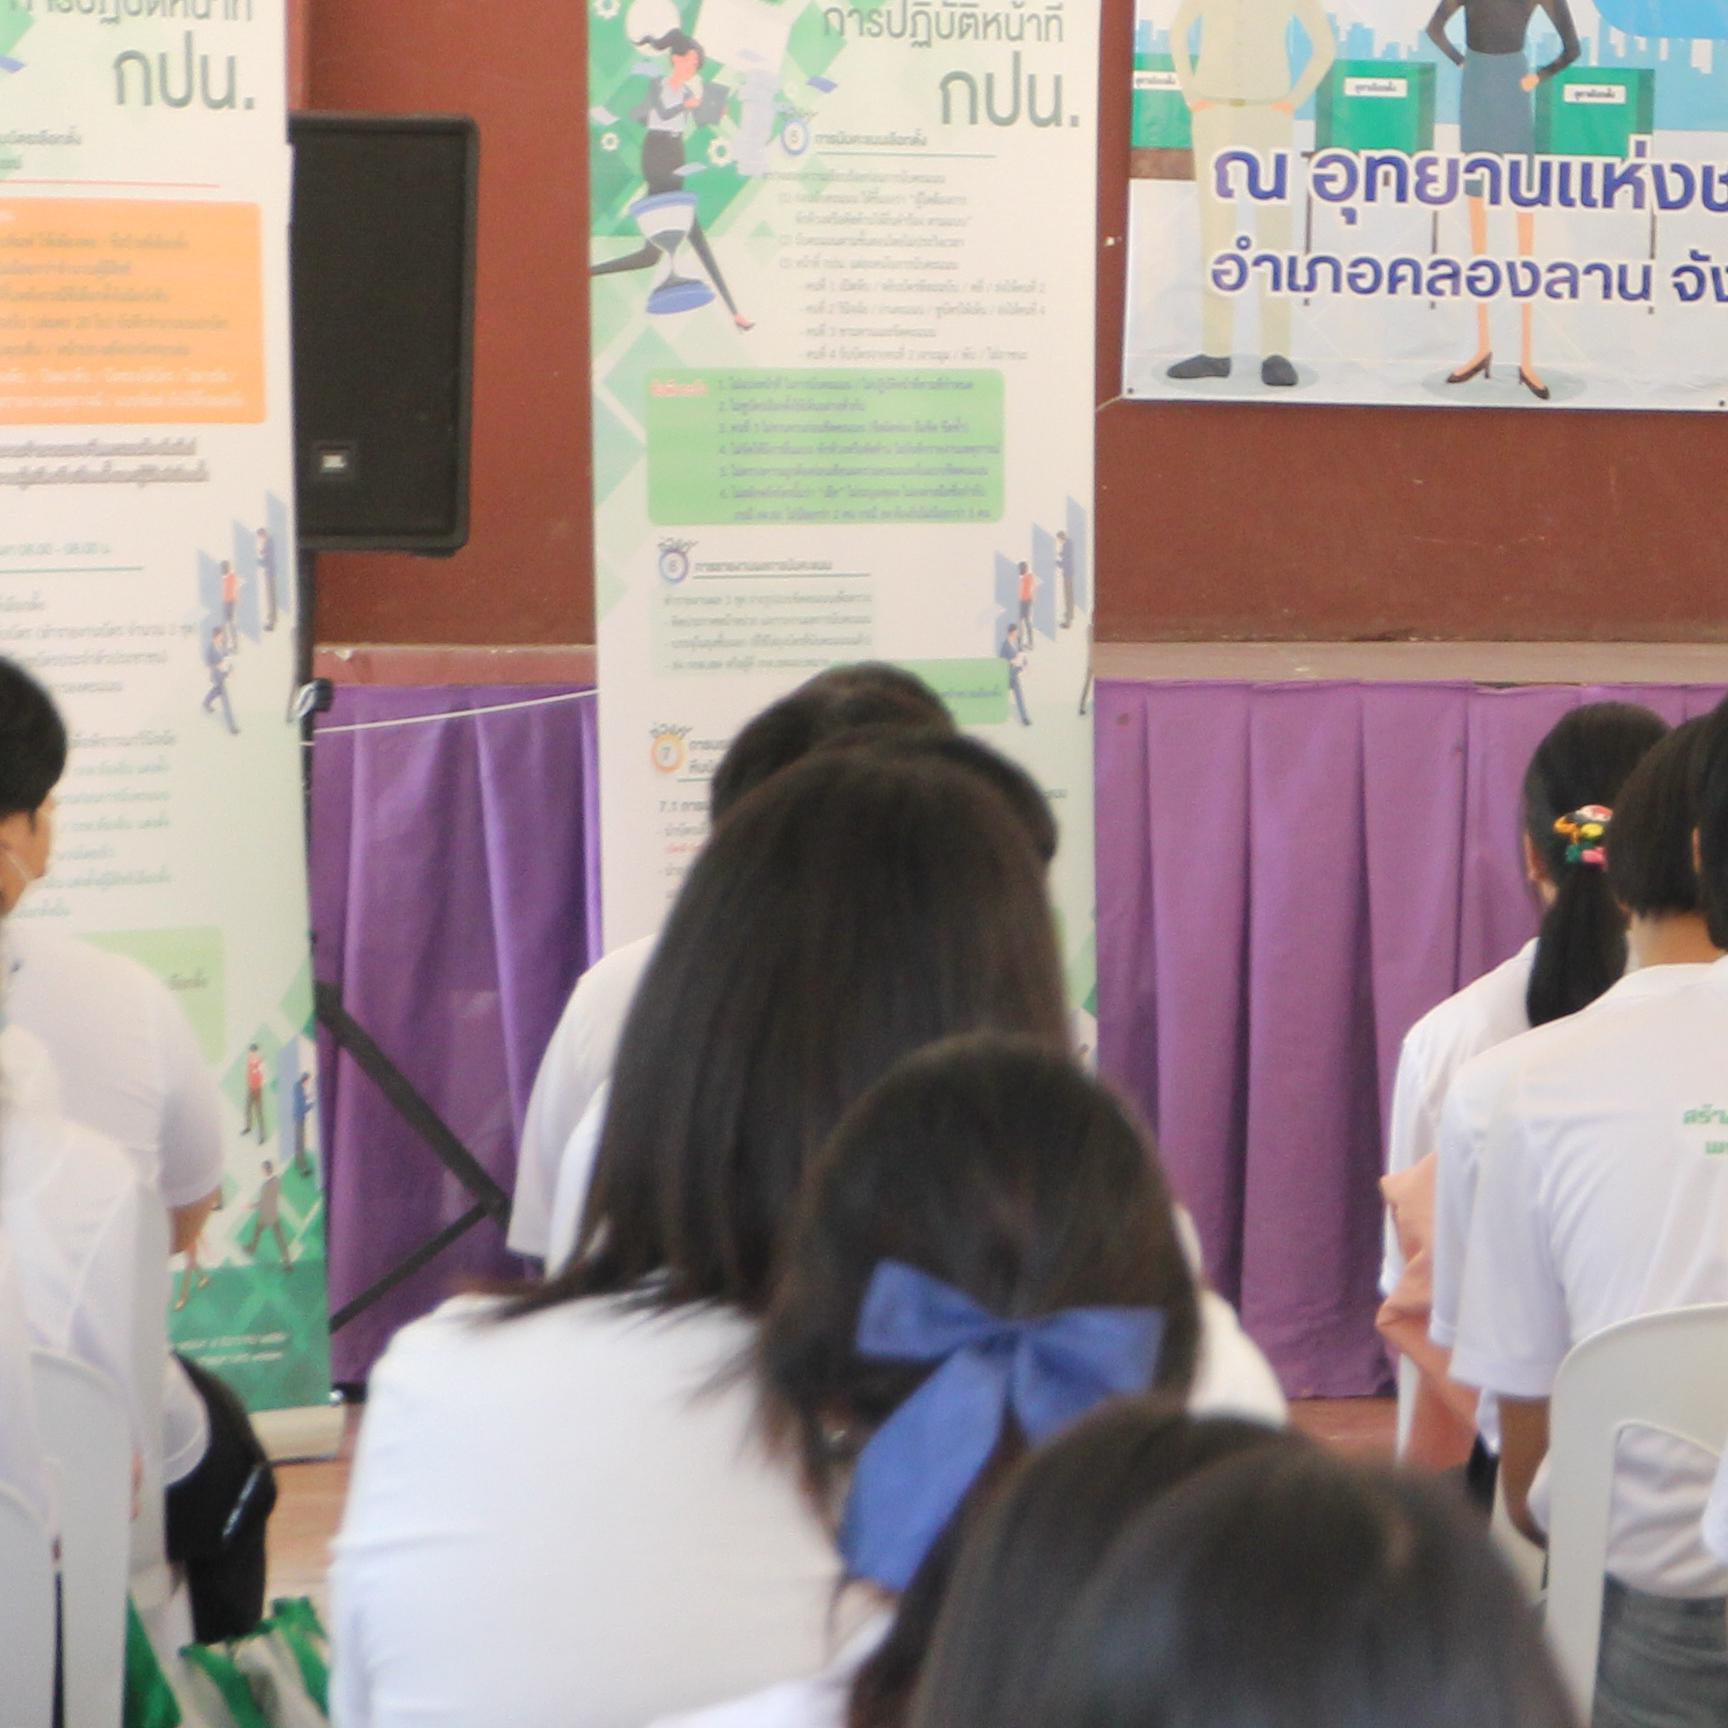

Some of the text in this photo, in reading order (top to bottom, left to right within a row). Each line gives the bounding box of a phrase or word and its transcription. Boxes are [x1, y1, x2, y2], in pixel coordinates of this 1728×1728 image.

[113, 30, 256, 111] กปน.
[939, 50, 1081, 128] กปน.
[1213, 149, 1288, 201] ณ
[1211, 235, 1651, 302] อำเภอคลองลาน
